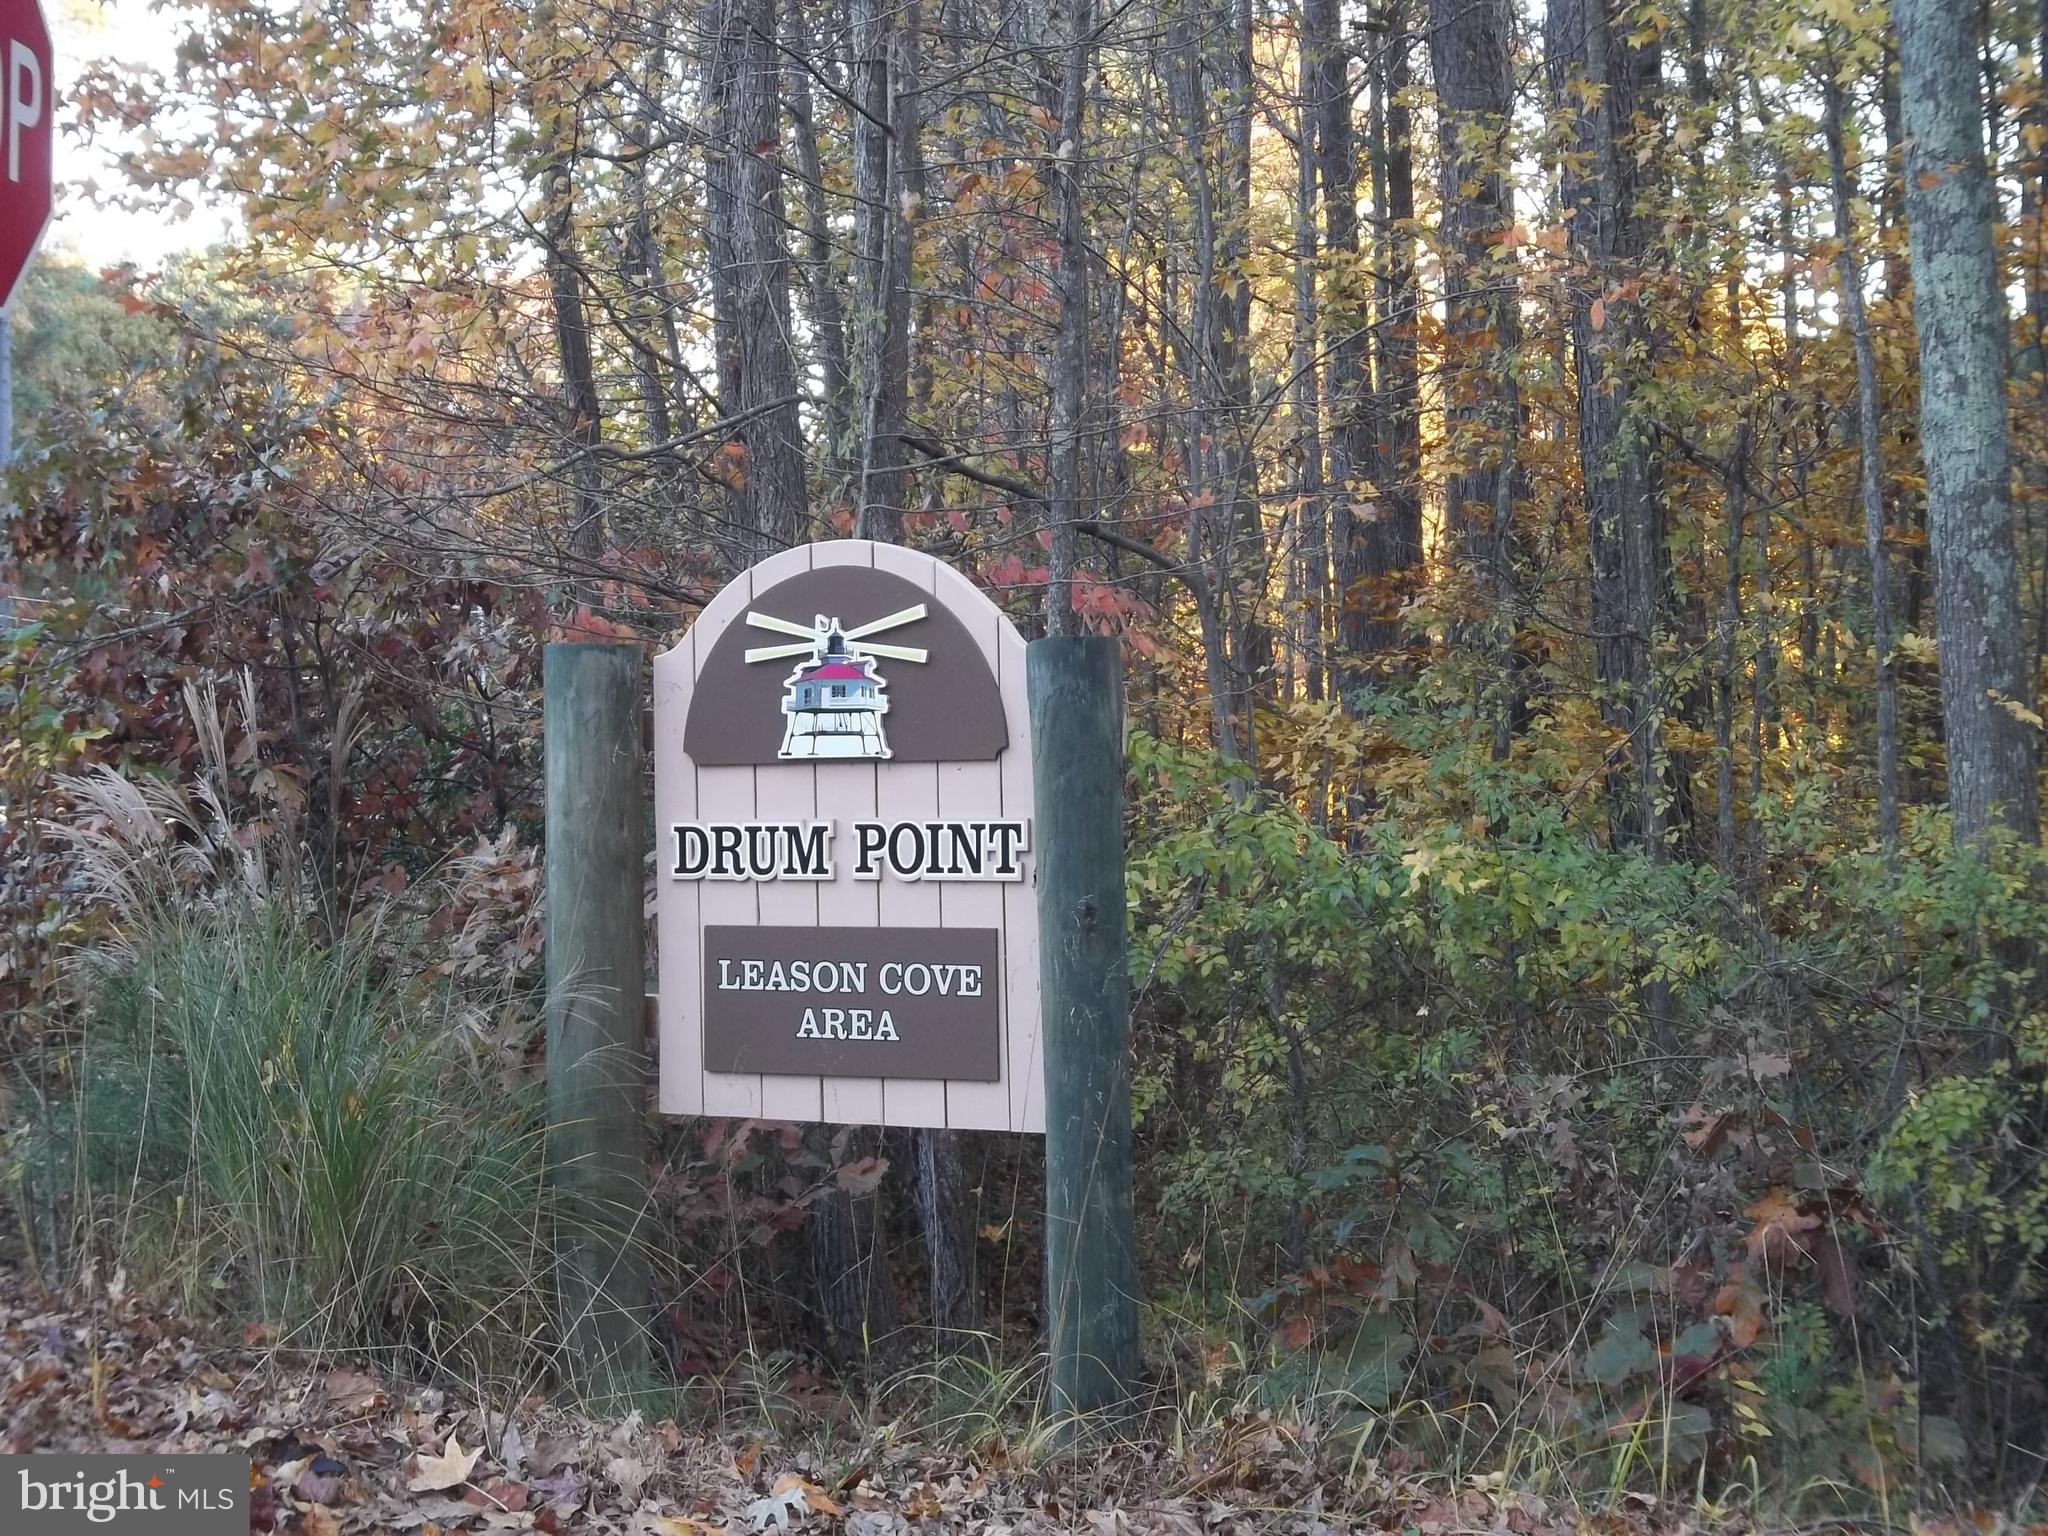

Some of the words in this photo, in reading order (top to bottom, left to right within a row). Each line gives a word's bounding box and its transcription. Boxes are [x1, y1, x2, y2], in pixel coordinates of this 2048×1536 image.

[0, 38, 42, 183] P
[673, 823, 831, 876] DRUM
[853, 821, 1023, 876] POINT
[717, 958, 868, 993] LEASON
[878, 962, 983, 997] COVE
[795, 1007, 900, 1041] AREA
